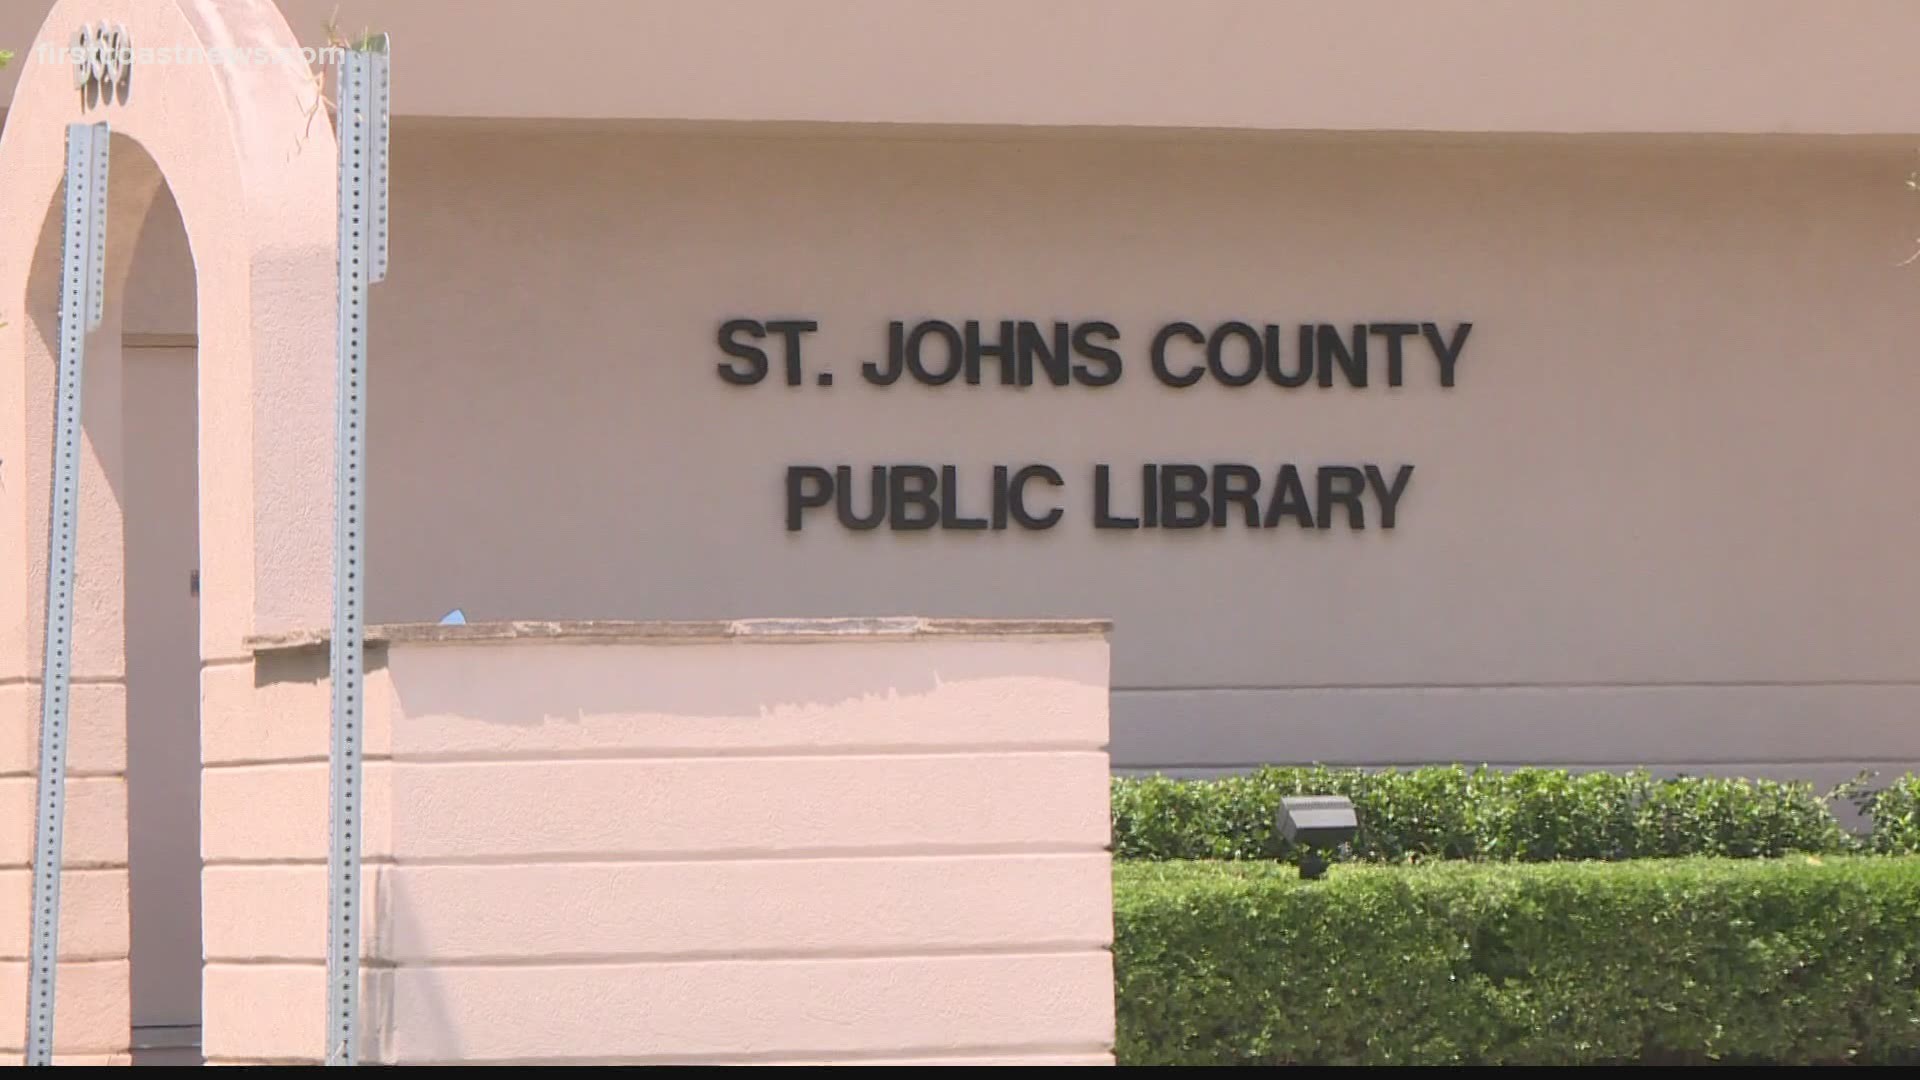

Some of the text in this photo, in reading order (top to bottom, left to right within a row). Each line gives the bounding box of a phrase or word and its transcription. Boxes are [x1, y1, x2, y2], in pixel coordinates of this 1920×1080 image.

[716, 319, 1472, 388] ST. JOHNS COUNTY
[785, 464, 1414, 532] PUBLIC LIBRARY
